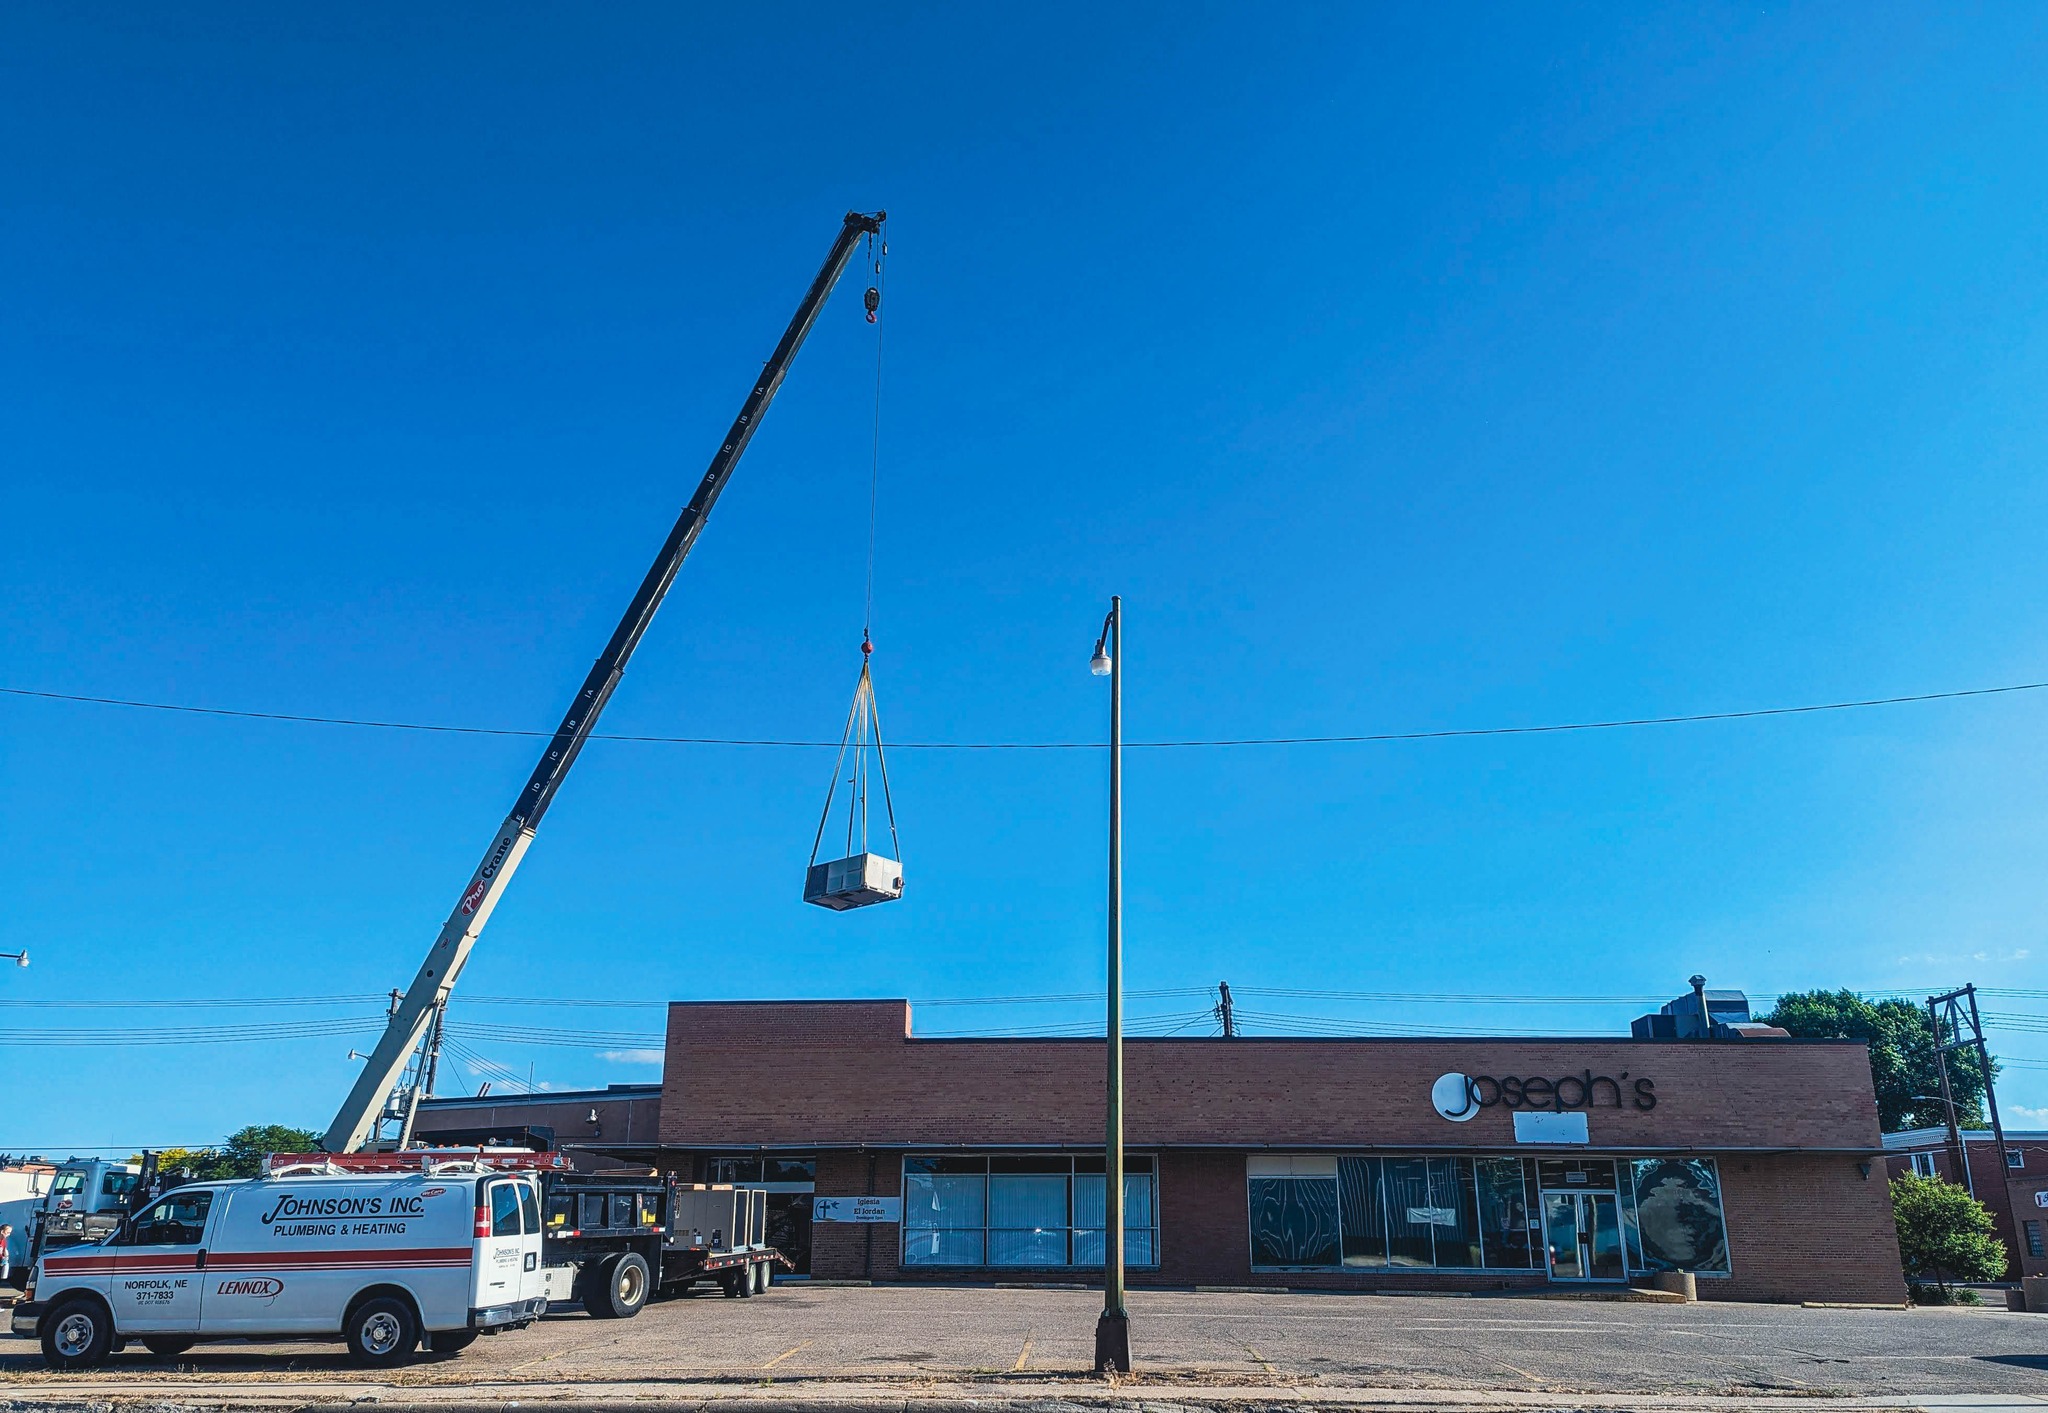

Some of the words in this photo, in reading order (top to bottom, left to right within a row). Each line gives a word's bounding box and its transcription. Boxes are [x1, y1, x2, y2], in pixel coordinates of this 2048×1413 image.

[461, 880, 484, 913] Pro
[481, 837, 512, 879] Crane
[261, 1194, 383, 1224] JOHNSON'S
[388, 1196, 425, 1213] INC.
[857, 1198, 880, 1207] Iglesia
[273, 1224, 336, 1236] PLUMBING
[340, 1224, 349, 1236] &
[352, 1222, 406, 1235] HEATING
[124, 1280, 171, 1290] NORFOLK,
[174, 1279, 188, 1288] NE
[217, 1281, 273, 1295] LENNOX
[136, 1291, 174, 1300] 371-7833
